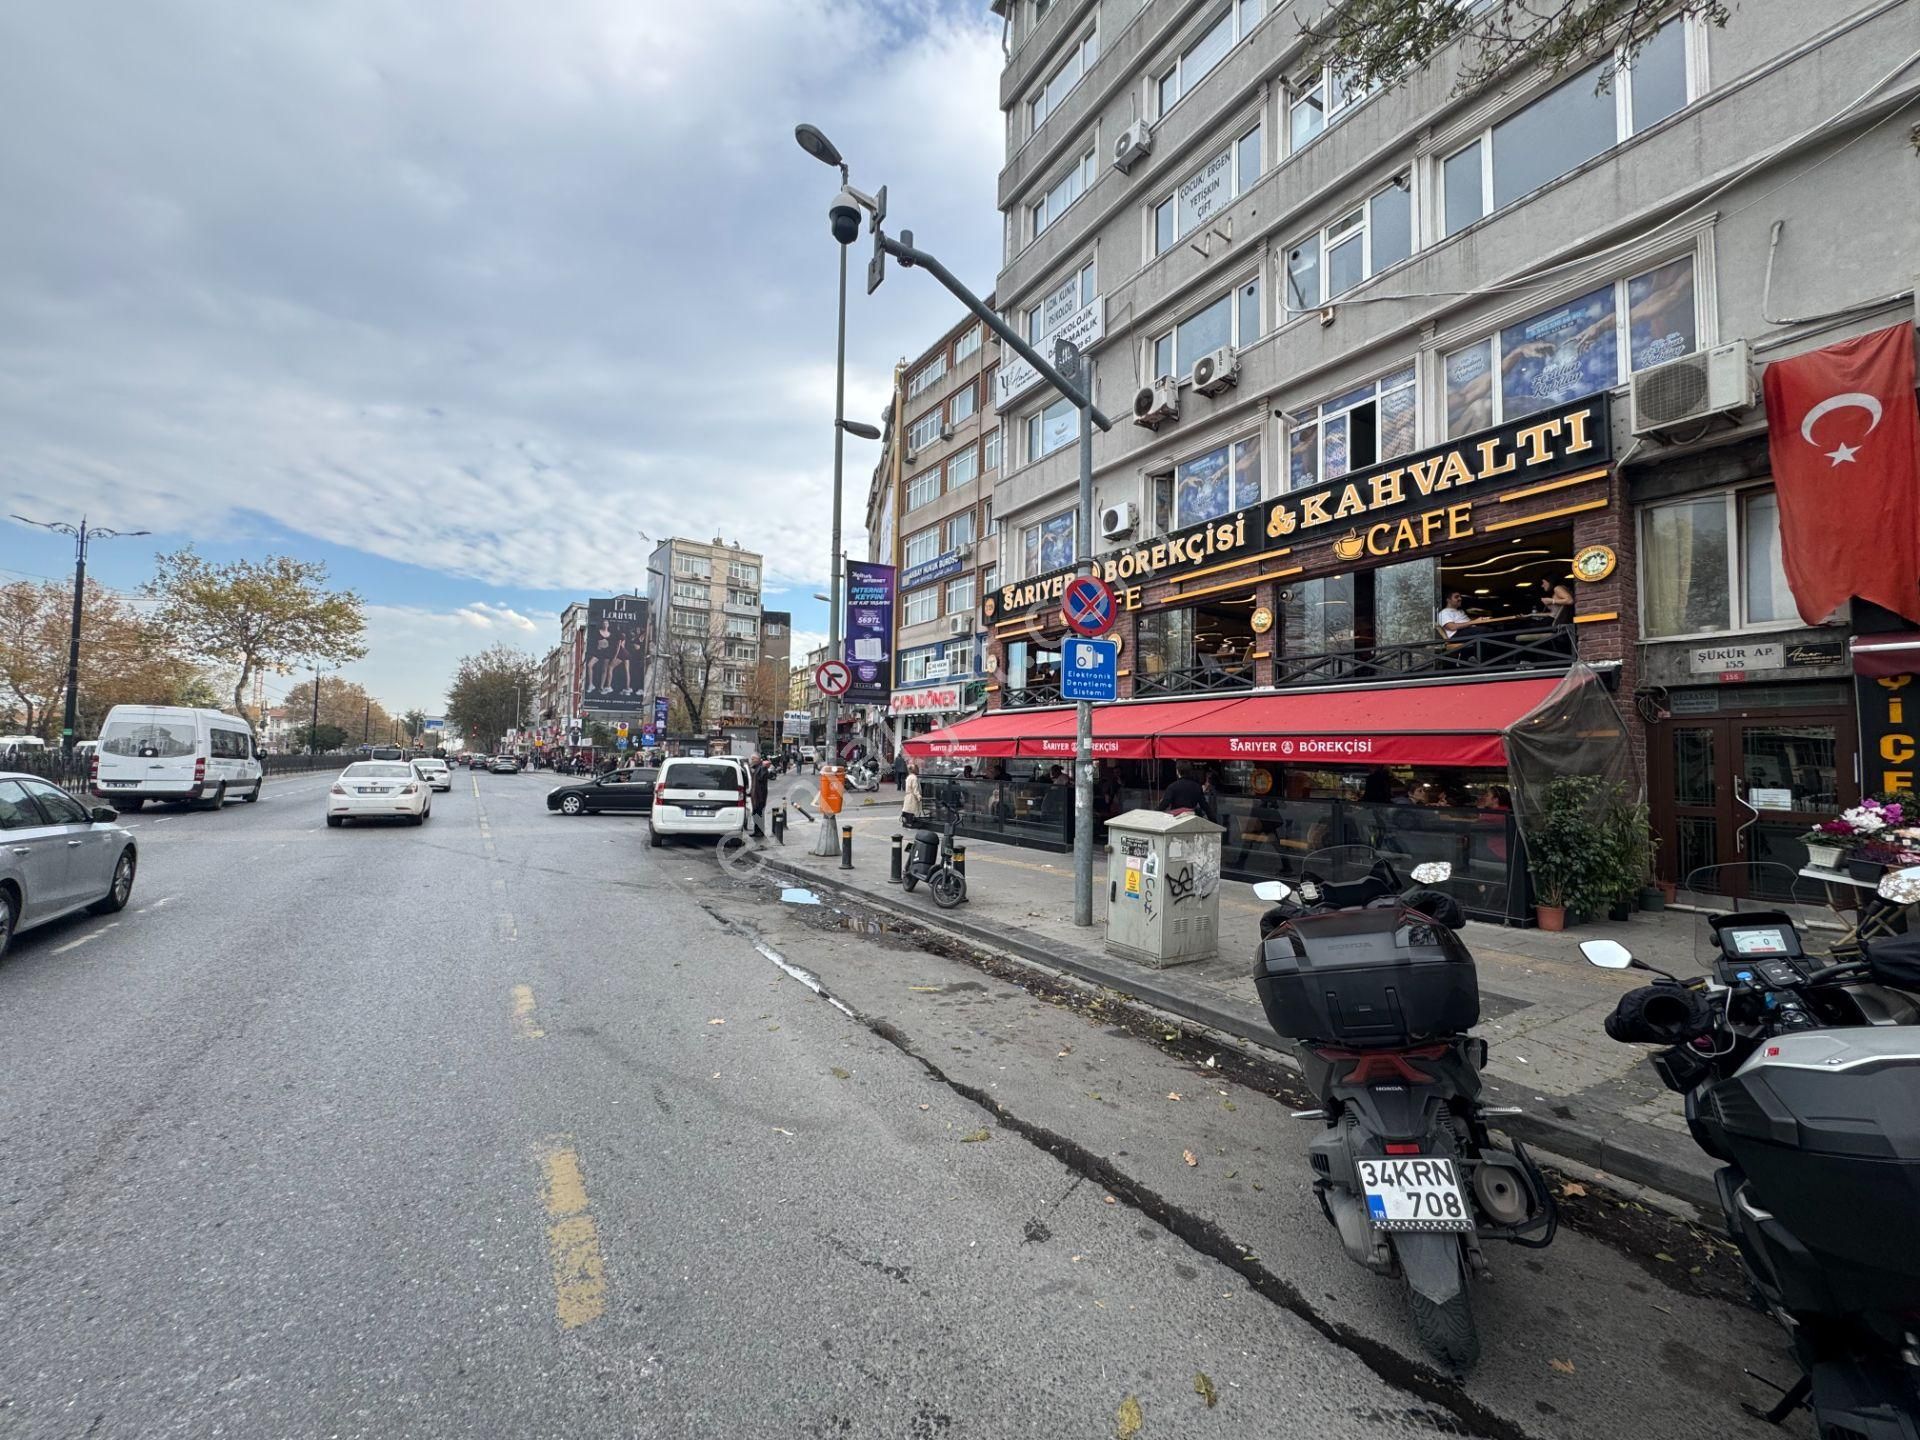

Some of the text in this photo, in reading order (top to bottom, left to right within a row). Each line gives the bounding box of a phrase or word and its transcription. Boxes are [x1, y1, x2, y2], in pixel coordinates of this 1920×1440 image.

[1207, 151, 1231, 177] ERGEN
[1367, 501, 1475, 556] CAFE
[1104, 511, 1246, 584] BÖREKÇİSİ
[1698, 647, 1775, 663] ŞÜKÜR AP.
[1725, 660, 1745, 669] 155
[1067, 670, 1112, 680] Elektronik
[1066, 679, 1113, 689] Denetleme
[1073, 687, 1106, 696] Sistemi
[1042, 739, 1119, 752] SARIYER REKÇİSİ
[1230, 738, 1372, 755] SARIYER BÖREKÇİSİ
[1406, 1191, 1462, 1218] 708
[1374, 1210, 1385, 1218] TR
